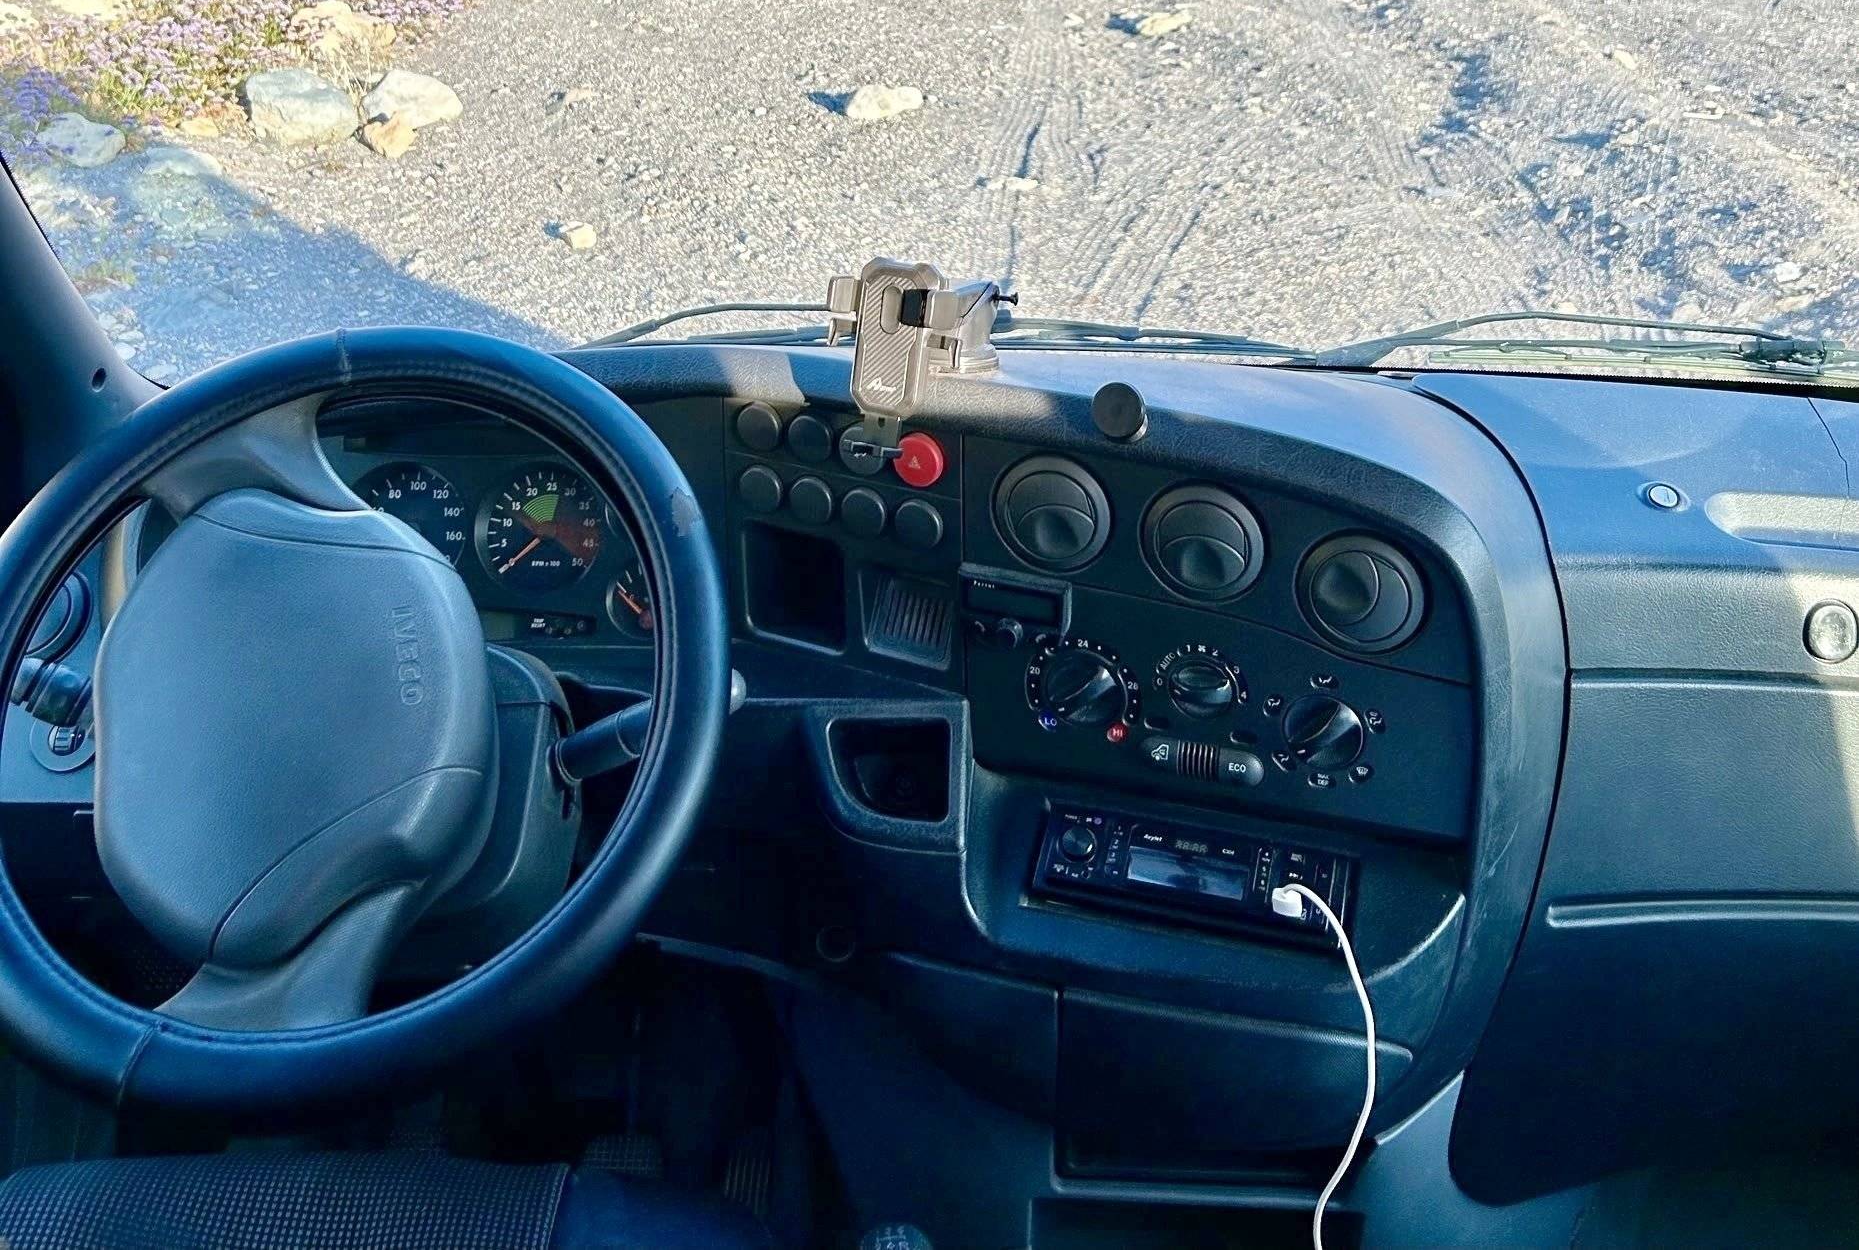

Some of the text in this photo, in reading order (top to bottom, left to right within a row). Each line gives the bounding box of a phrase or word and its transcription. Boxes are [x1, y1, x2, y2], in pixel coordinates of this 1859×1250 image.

[410, 481, 427, 491] 100
[546, 482, 557, 491] 25
[388, 489, 402, 499] 80
[432, 489, 449, 499] 120
[526, 488, 538, 497] 20
[564, 487, 576, 496] 30
[511, 501, 521, 510] 15
[444, 507, 460, 517] 140
[503, 518, 513, 527] 10
[583, 519, 595, 527] 40
[446, 531, 462, 541] 160
[501, 538, 508, 548] 5
[571, 558, 583, 566] 50
[1077, 639, 1089, 648] 24
[391, 605, 423, 705] IVECO
[1159, 652, 1176, 670] AUTO
[1030, 666, 1041, 675] 20
[1233, 666, 1240, 674] 3
[1240, 691, 1247, 699] 4
[1044, 717, 1057, 727] LO
[1112, 728, 1123, 738] HI
[1228, 762, 1247, 773] ECO
